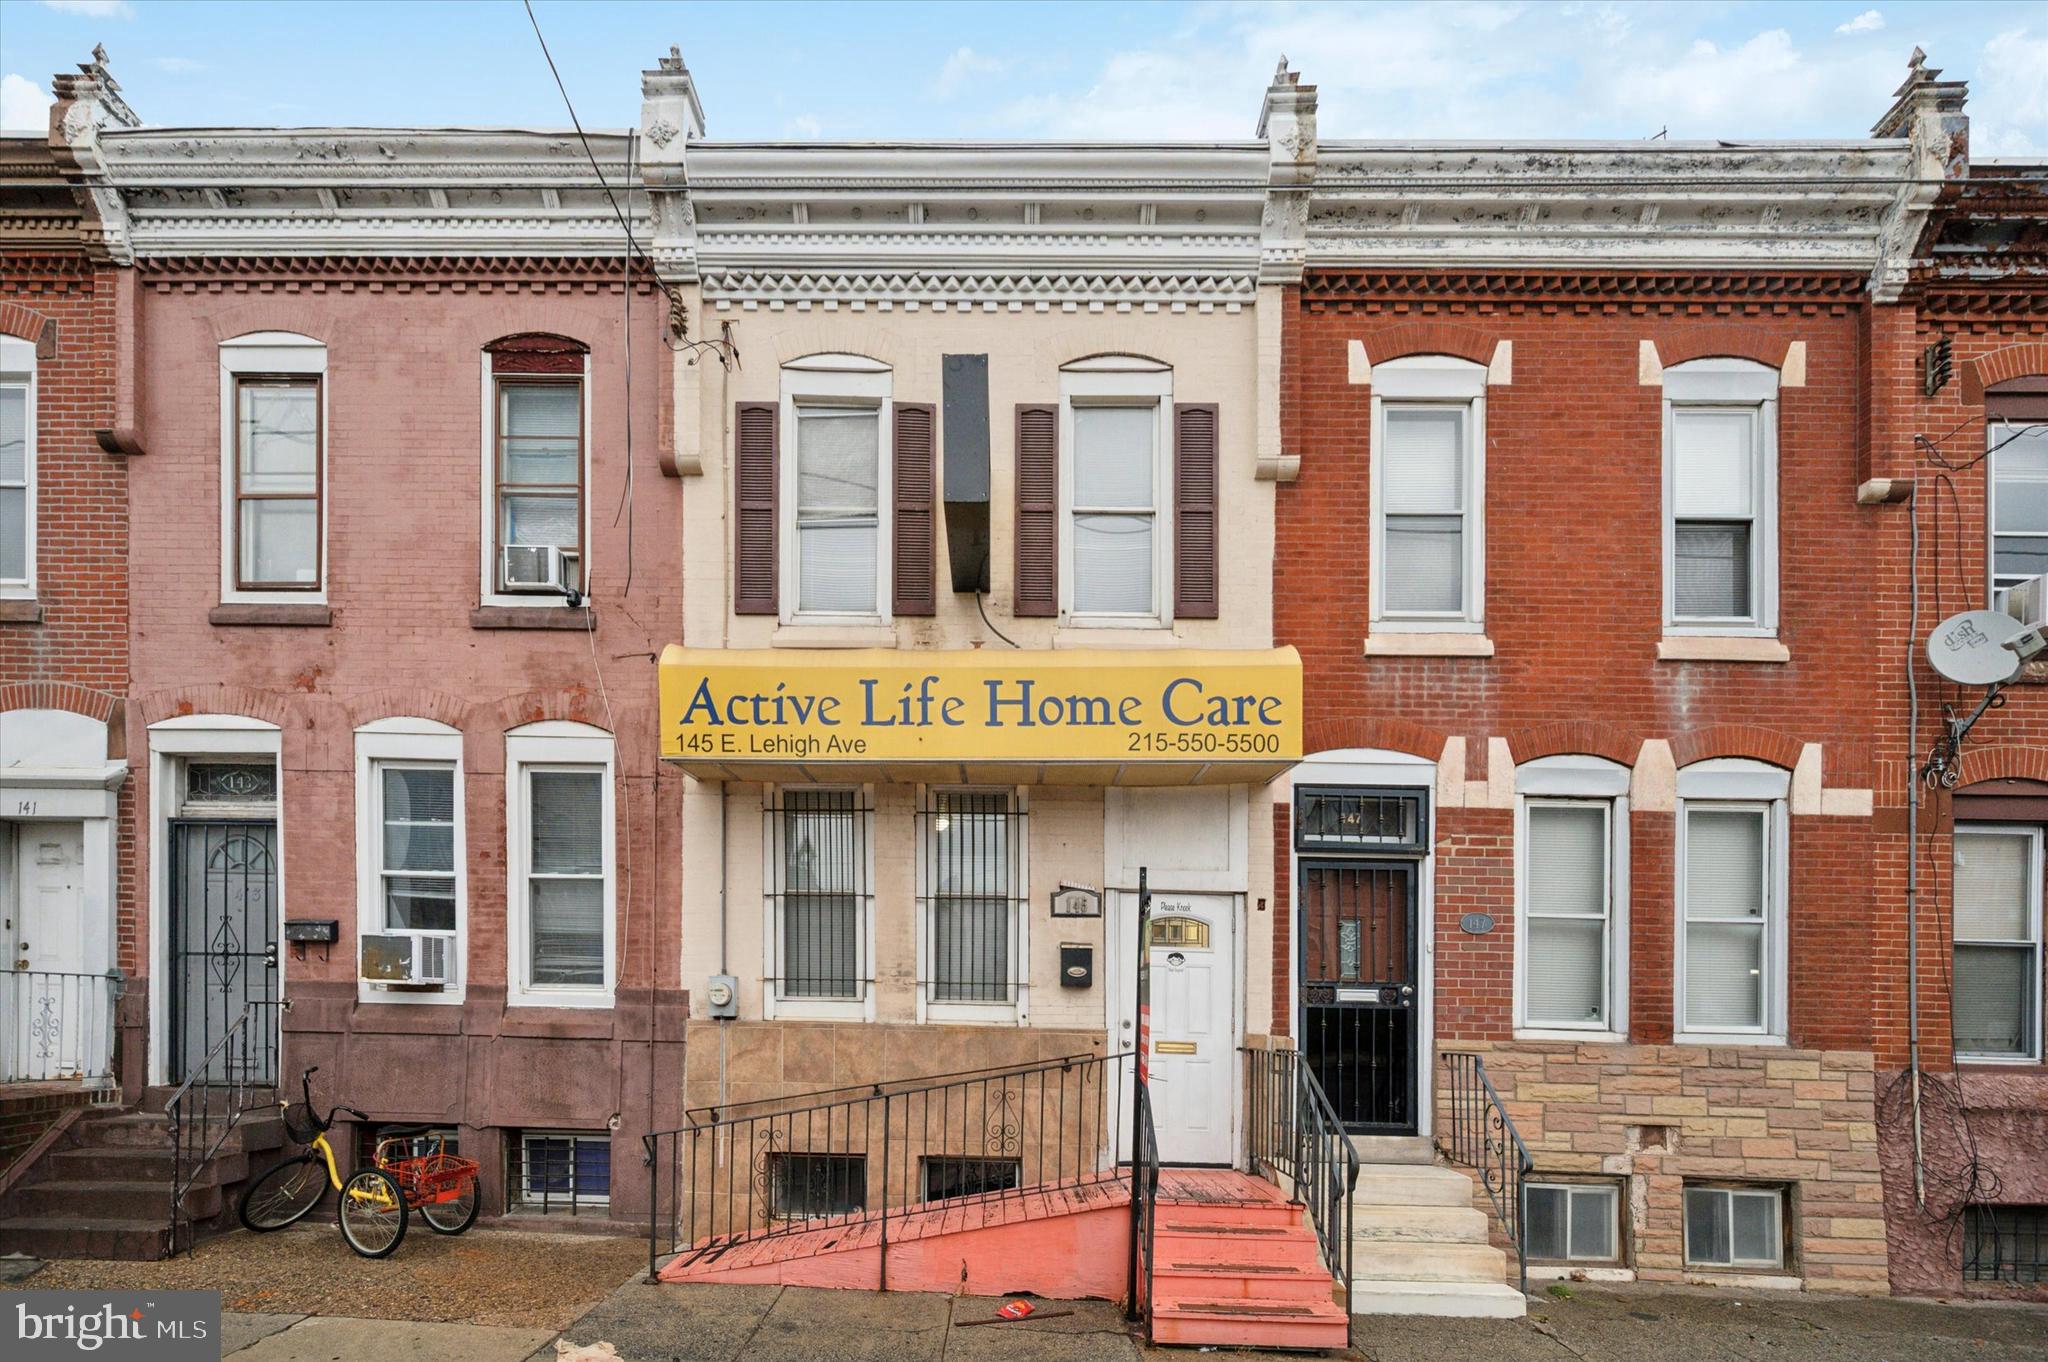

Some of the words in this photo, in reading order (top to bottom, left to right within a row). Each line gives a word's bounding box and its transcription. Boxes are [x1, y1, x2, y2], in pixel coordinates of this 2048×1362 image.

[680, 677, 841, 726] Active
[859, 676, 965, 728] Life
[984, 680, 1142, 728] Home
[1162, 678, 1283, 727] Care
[675, 733, 714, 753] 145
[721, 734, 742, 753] E.
[750, 734, 820, 757] Lehigh
[826, 734, 867, 754] Ave
[1128, 732, 1280, 753] 215-550-5500
[18, 801, 37, 815] 141
